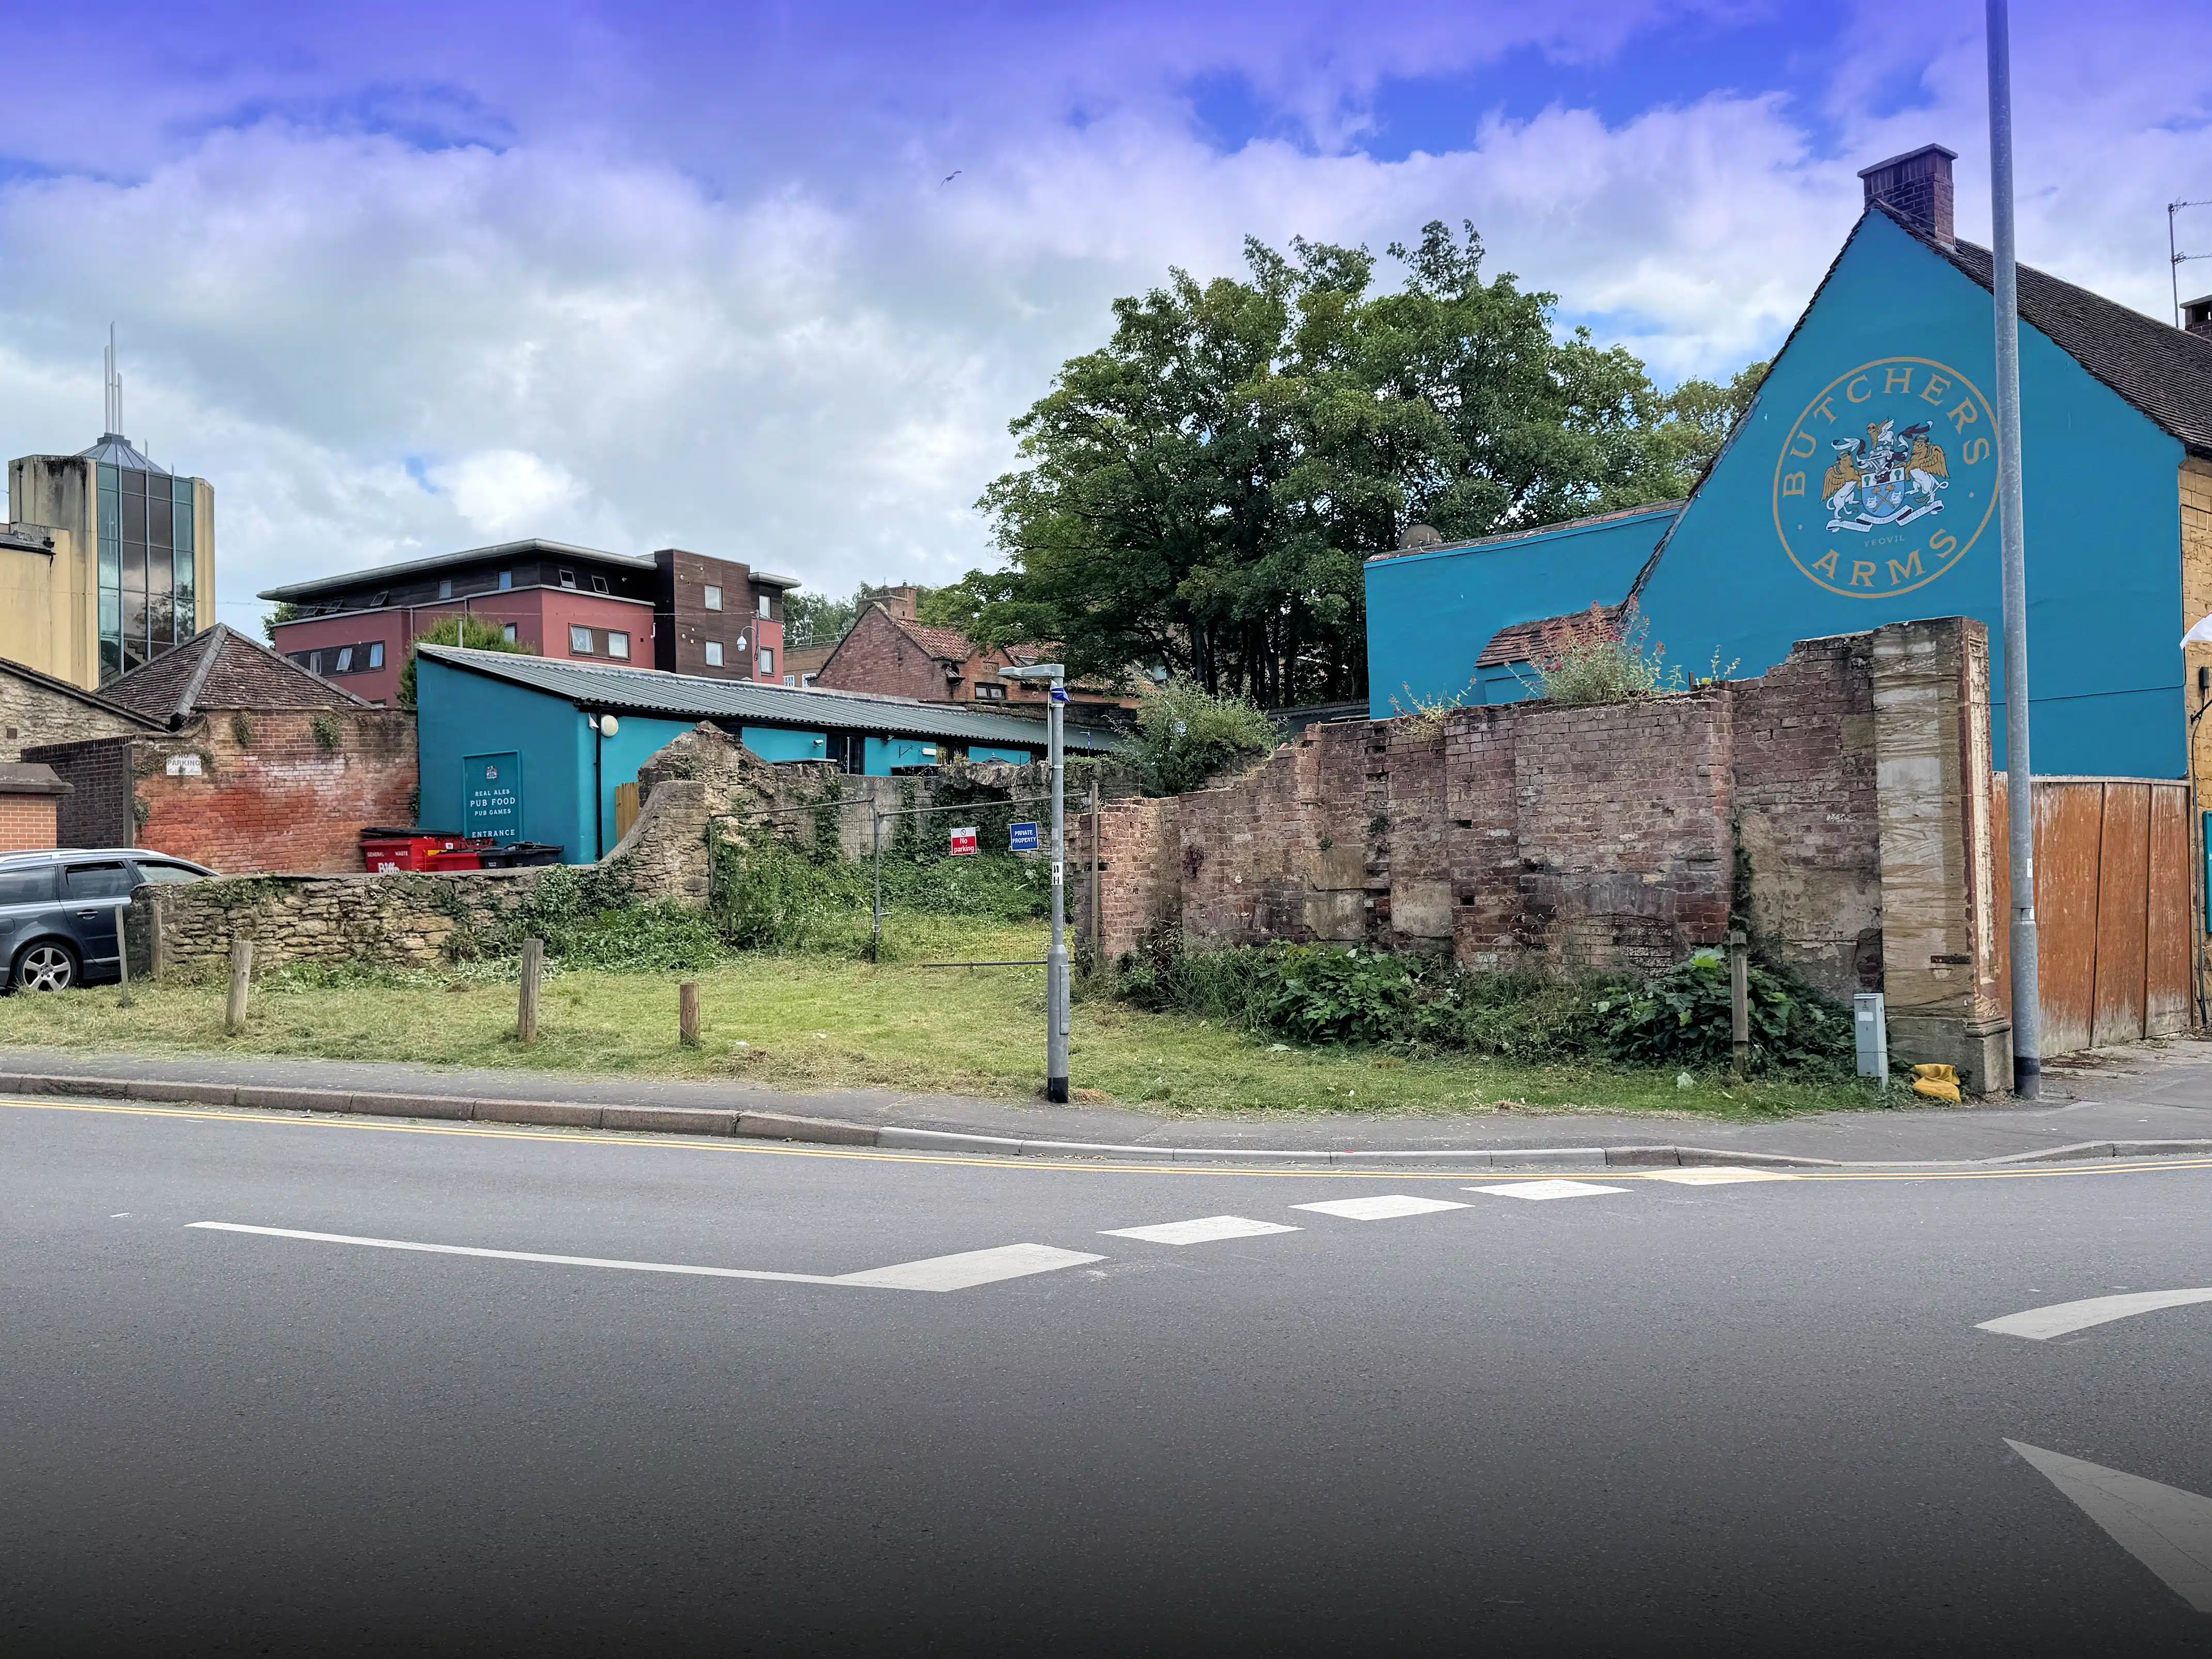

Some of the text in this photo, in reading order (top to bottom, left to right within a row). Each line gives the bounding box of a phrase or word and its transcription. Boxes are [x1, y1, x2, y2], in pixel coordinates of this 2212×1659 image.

[1783, 368, 1990, 498] BUTCHERS
[1864, 534, 1906, 548] YEOVIL
[1811, 528, 1957, 588] ARMS
[492, 797, 515, 805] FOOD
[472, 829, 515, 838] ENTRANCE
